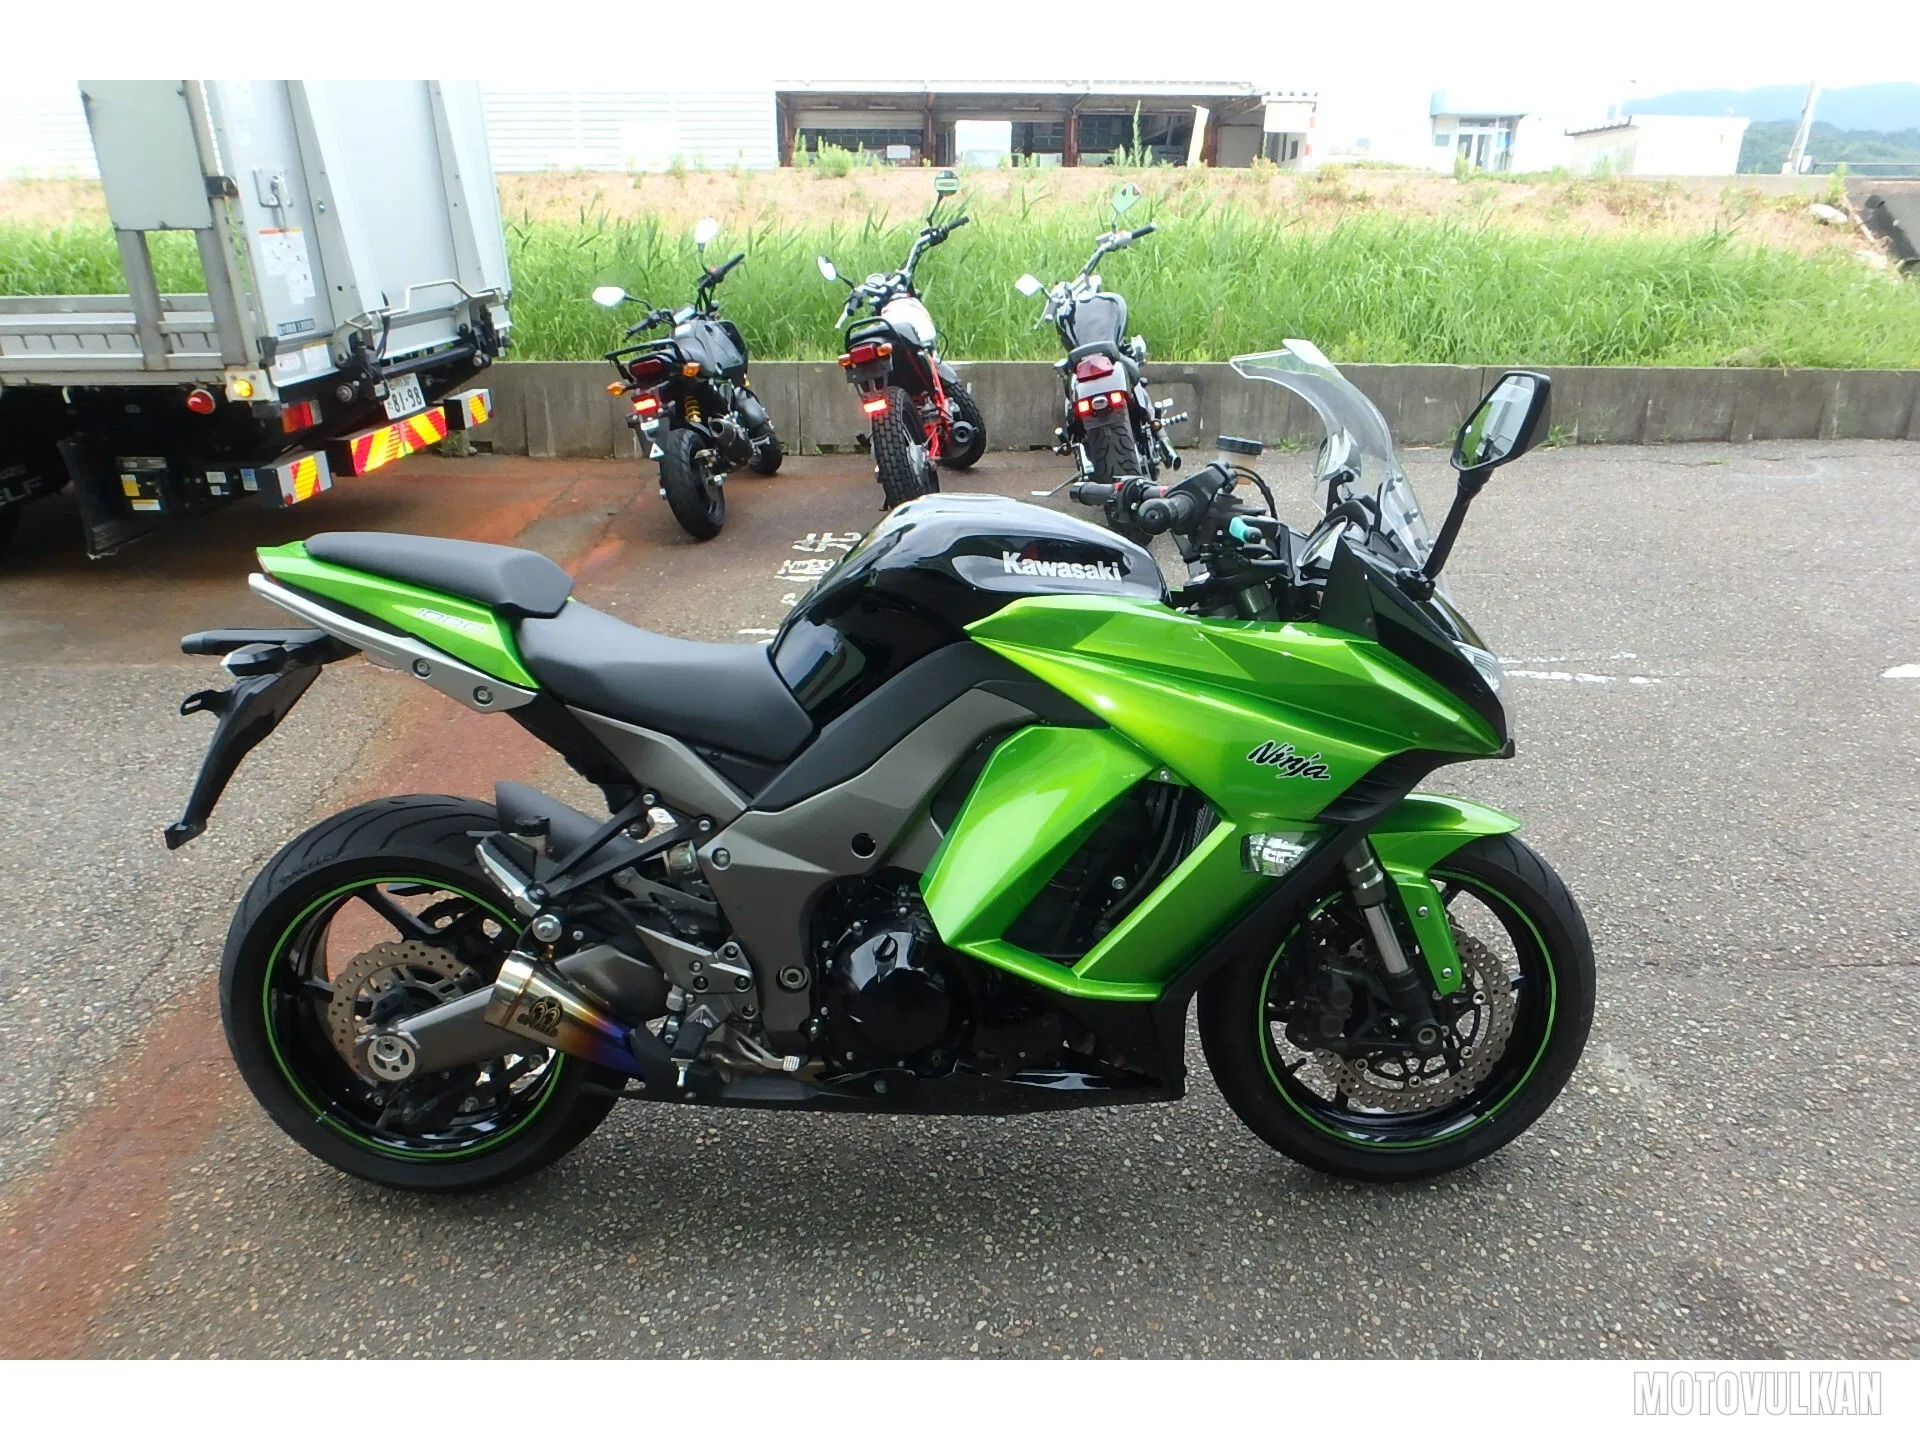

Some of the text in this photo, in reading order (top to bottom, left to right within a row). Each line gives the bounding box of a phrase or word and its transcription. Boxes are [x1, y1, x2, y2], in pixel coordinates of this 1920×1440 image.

[1002, 551, 1122, 581] Kawasaki
[417, 607, 486, 633] 1000
[1247, 740, 1331, 780] Ninja
